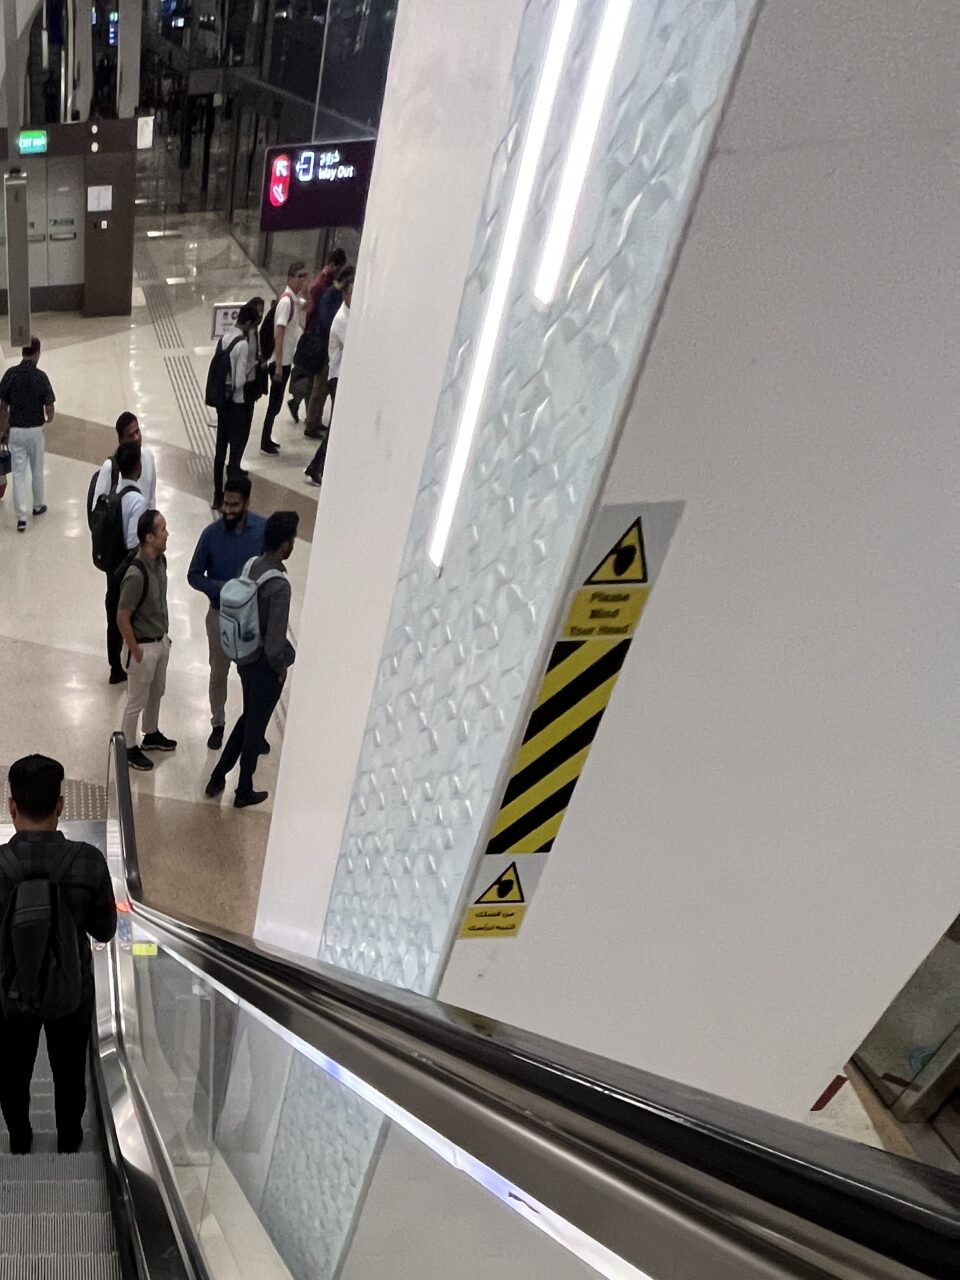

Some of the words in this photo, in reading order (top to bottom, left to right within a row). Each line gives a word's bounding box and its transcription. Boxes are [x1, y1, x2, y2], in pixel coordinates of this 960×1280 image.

[318, 167, 337, 181] Way
[337, 165, 354, 179] Out
[589, 591, 630, 603] Please
[589, 608, 620, 619] Mind
